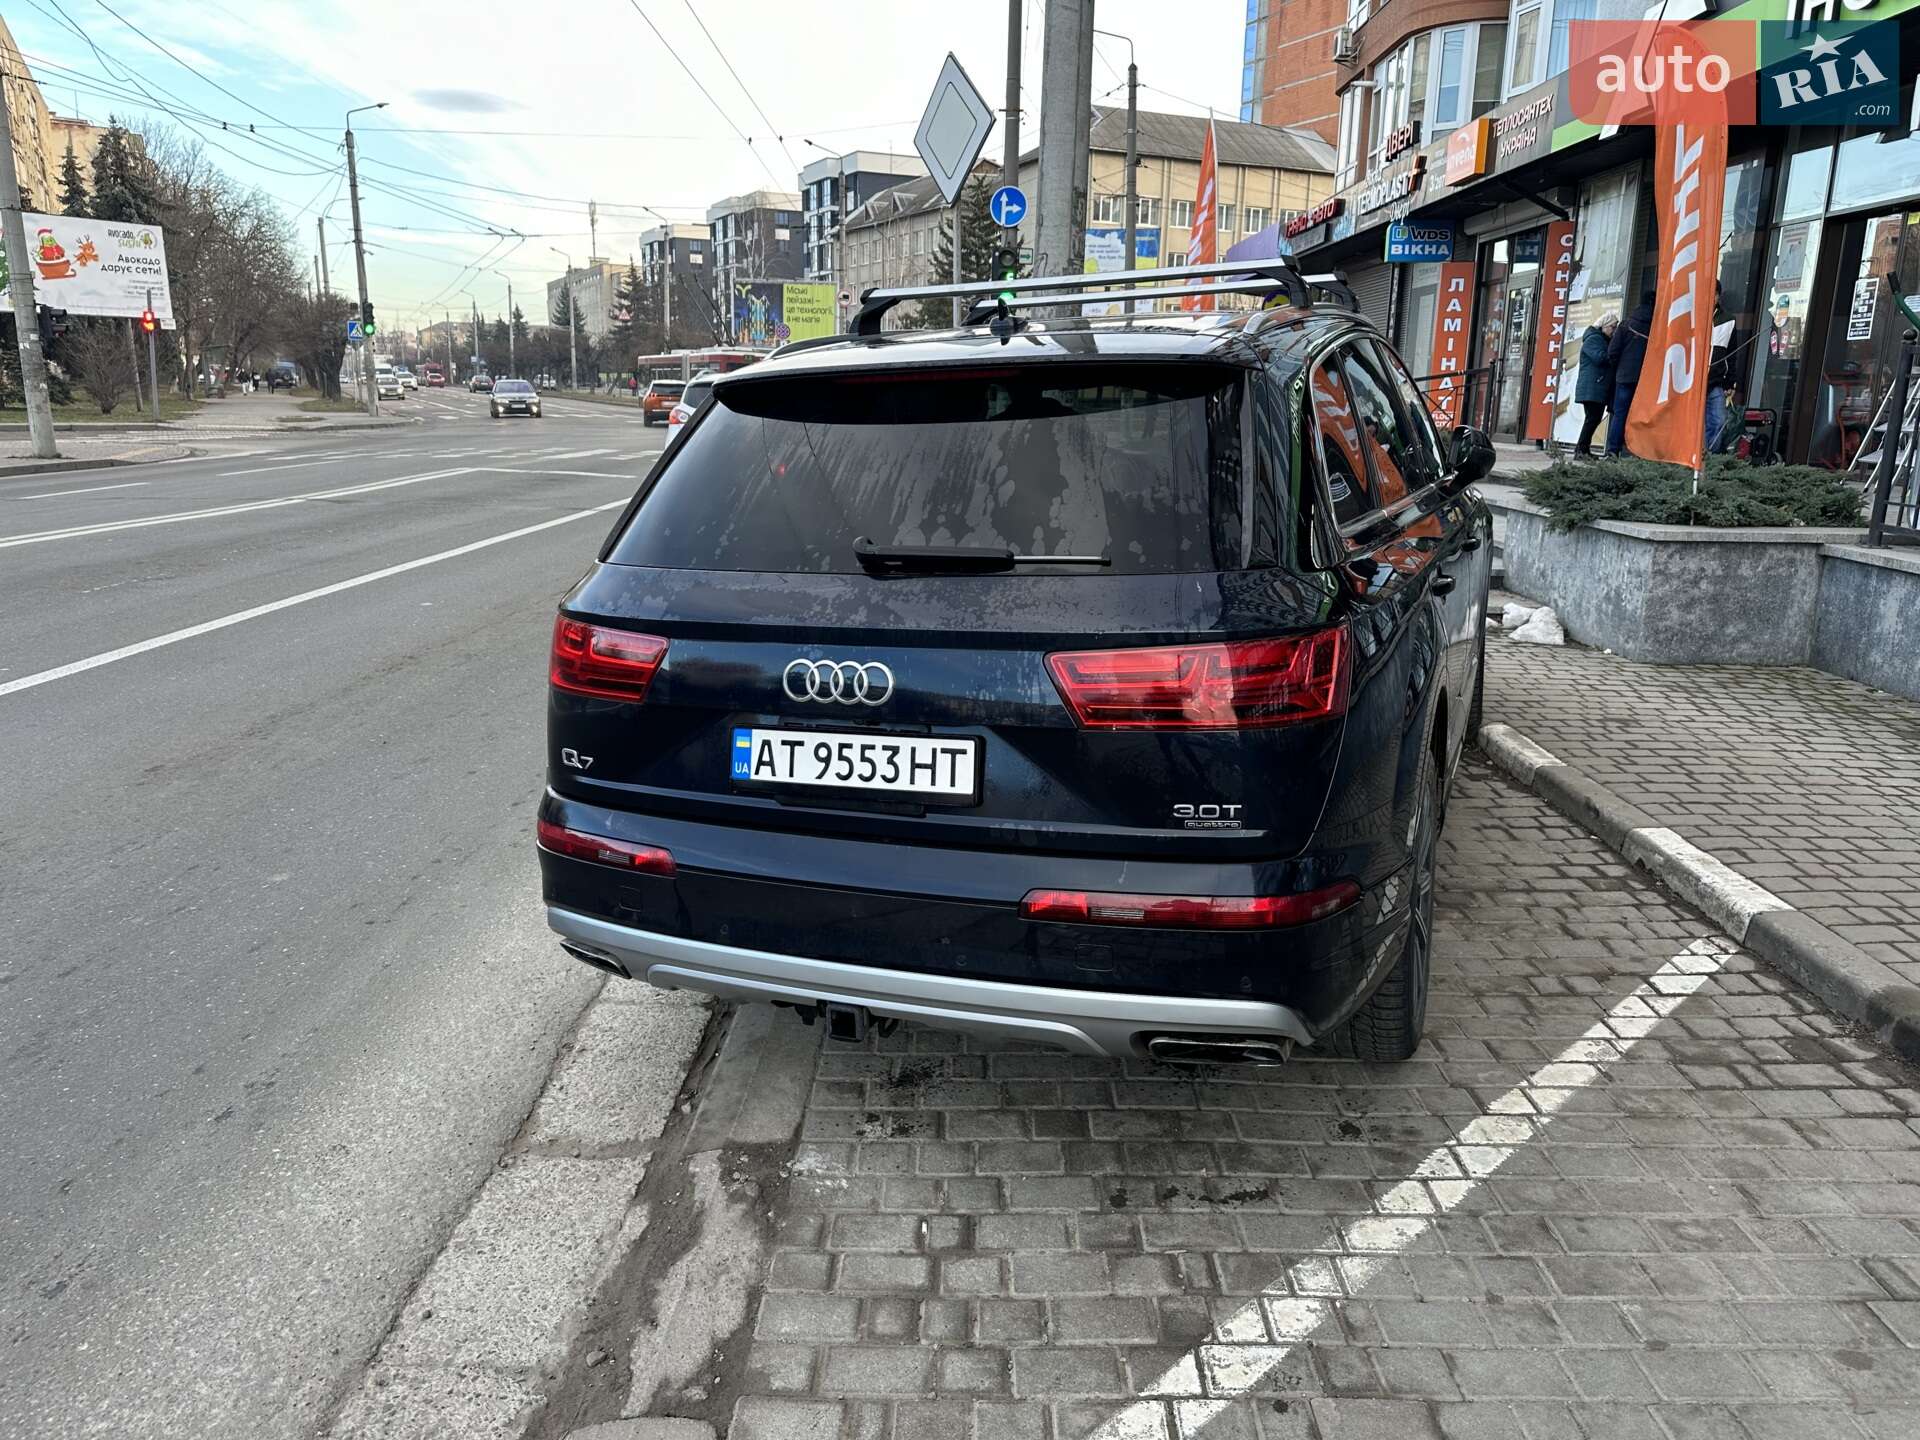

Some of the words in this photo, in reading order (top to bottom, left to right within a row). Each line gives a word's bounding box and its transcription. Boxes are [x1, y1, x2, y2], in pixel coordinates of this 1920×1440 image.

[1493, 94, 1554, 139] ТЕПЛОСАНТЕХ
[1385, 121, 1415, 160] ДВЕРІ
[1500, 126, 1538, 158] УКРАЇНА
[1409, 226, 1450, 241] WDS
[1390, 243, 1450, 255] ВІКНА
[117, 254, 160, 265] Авокадо
[101, 264, 132, 274] дарує
[135, 266, 162, 275] сети!
[1542, 234, 1574, 404] САНТЕХНІКА
[1438, 278, 1465, 410] ЛАМІНАТ
[562, 748, 594, 770] Q7
[734, 761, 749, 774] UA
[754, 738, 805, 778] AT
[813, 741, 900, 784] 9553
[910, 745, 968, 788] HT
[1173, 803, 1243, 819] 3.0T
[1187, 821, 1240, 829] quattro
